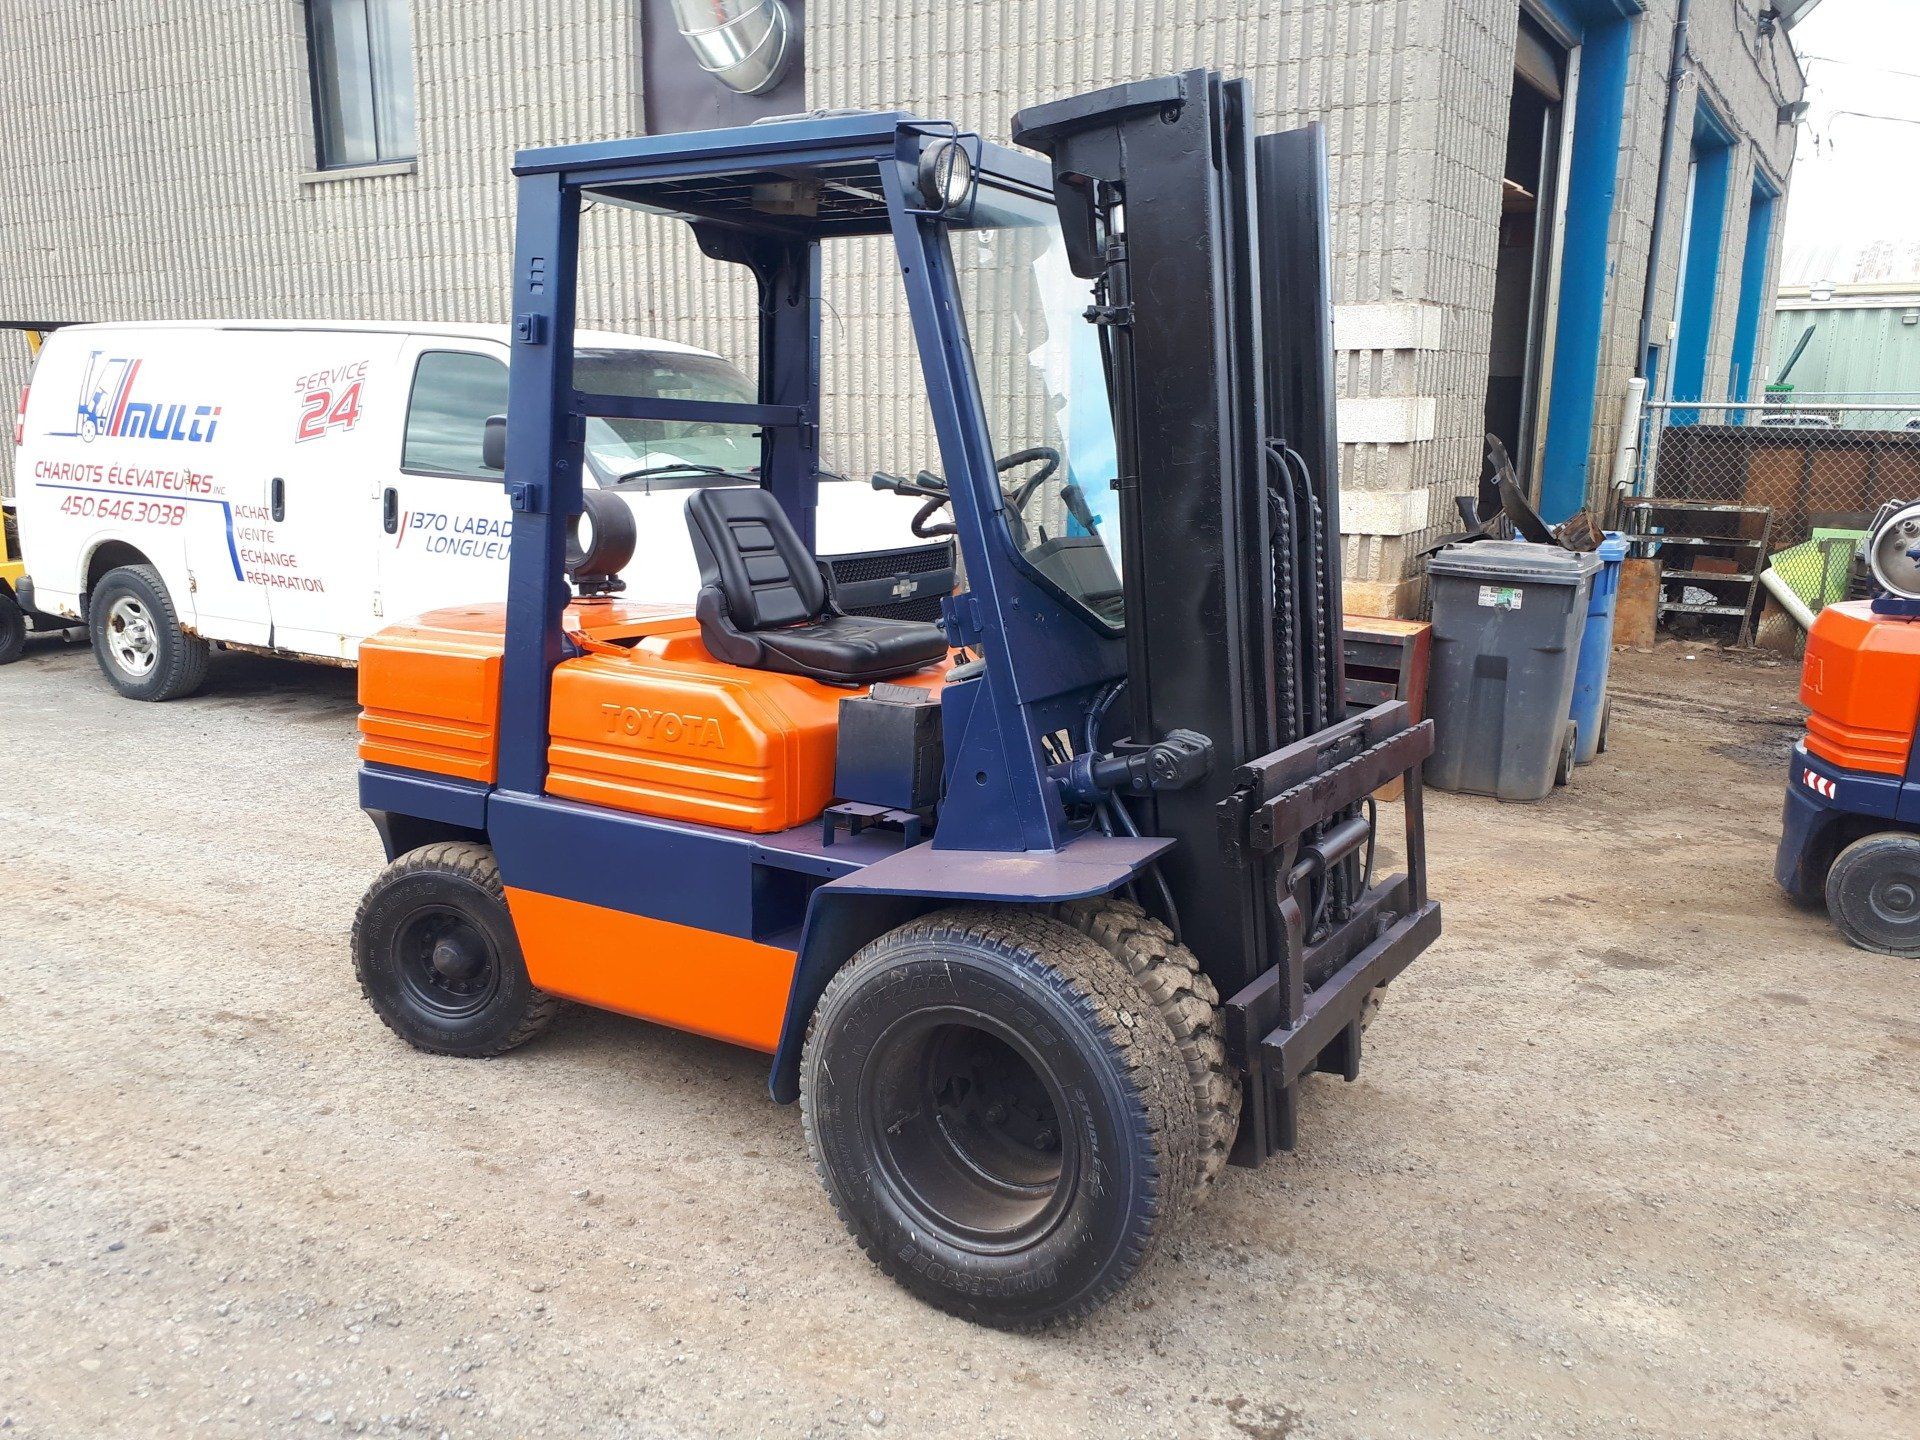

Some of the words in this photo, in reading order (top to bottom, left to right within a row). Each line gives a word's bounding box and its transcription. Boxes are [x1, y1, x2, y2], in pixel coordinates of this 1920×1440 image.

[294, 359, 369, 393] SERVICE
[295, 378, 365, 444] 24
[35, 461, 104, 483] CHARIOTS
[108, 461, 214, 494] ÉLÉVATEURS
[60, 495, 185, 526] 450.646.3038
[235, 504, 270, 521] ACHAT
[409, 511, 448, 531] 1370
[236, 527, 275, 543] VENTE
[240, 545, 299, 568] ÉCHANGE
[246, 569, 325, 593] RÉPARATION
[601, 702, 725, 750] TOYOTA
[1075, 1088, 1100, 1198] STUDLESS
